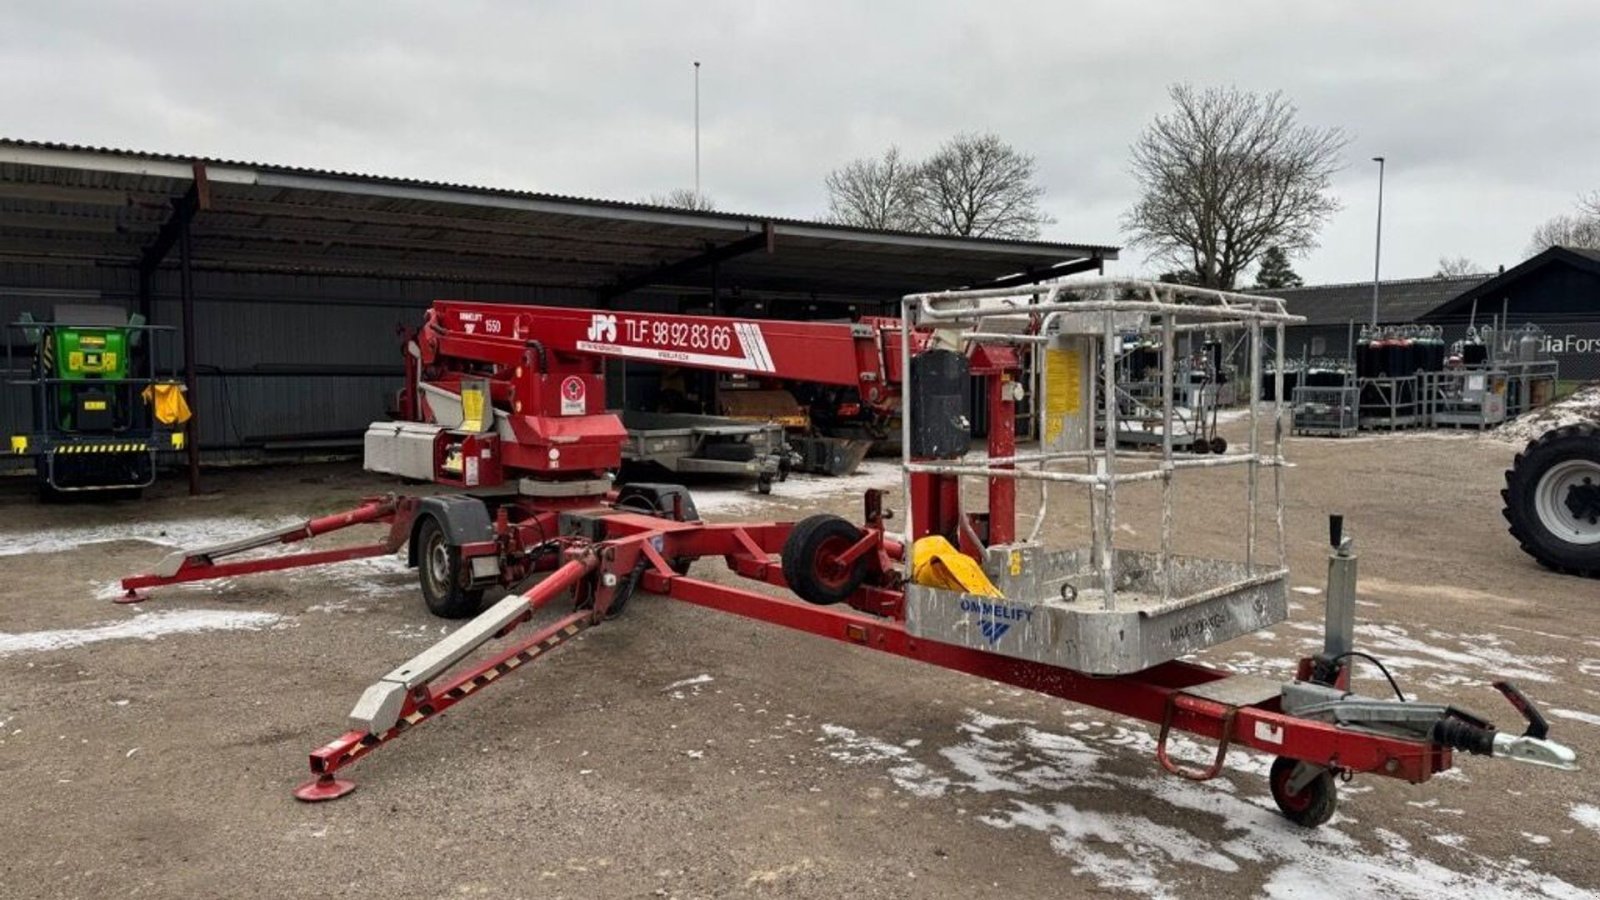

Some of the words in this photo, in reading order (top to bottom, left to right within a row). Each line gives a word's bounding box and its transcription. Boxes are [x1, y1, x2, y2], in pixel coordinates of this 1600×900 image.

[485, 319, 501, 333] 1550
[587, 314, 617, 342] JPS
[652, 321, 669, 345] 98
[671, 323, 689, 347] 92
[690, 324, 709, 349] 83
[711, 325, 731, 351] 66
[960, 599, 1034, 622] OMMELIFT
